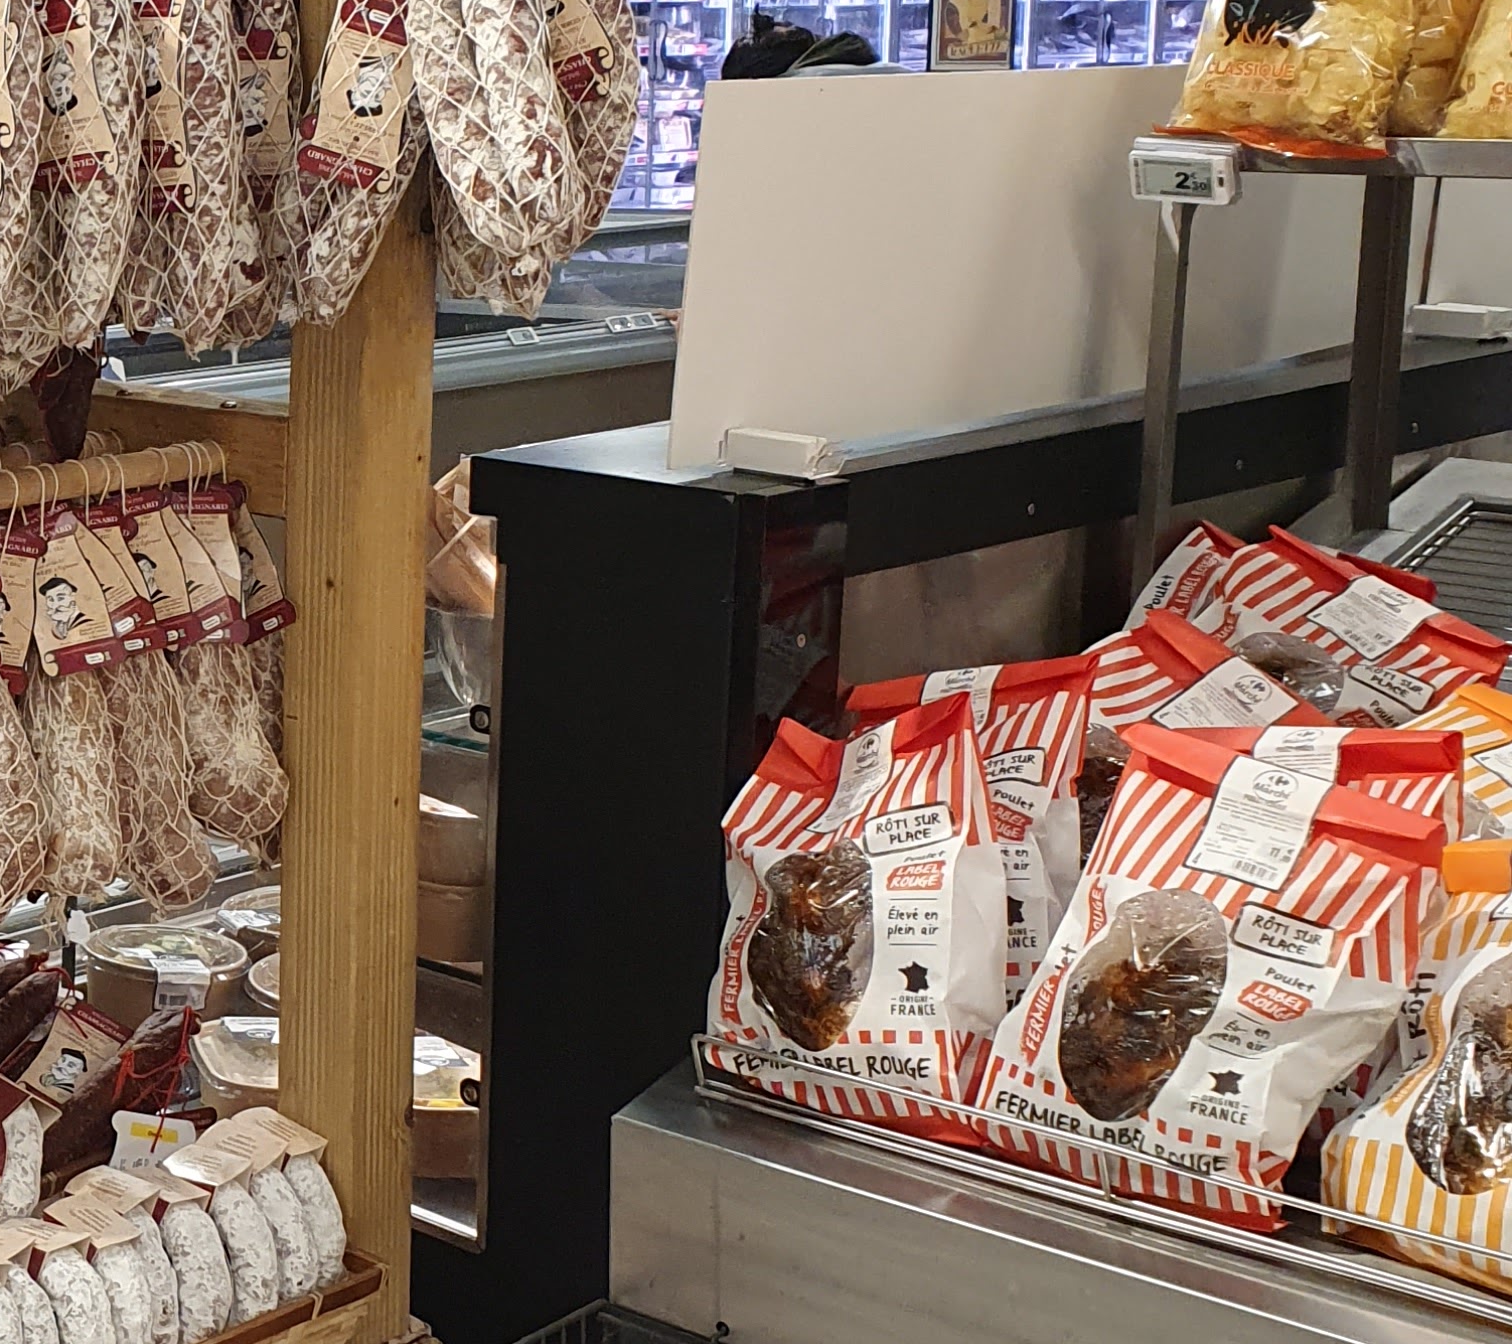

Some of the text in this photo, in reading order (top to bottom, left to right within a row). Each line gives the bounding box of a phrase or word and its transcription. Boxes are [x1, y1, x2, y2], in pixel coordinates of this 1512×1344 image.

[1207, 61, 1295, 80] CLASSIQUE
[1011, 754, 1036, 766] SUR
[994, 788, 1036, 812] Poulet
[876, 812, 942, 835] RÔTI SUR
[889, 827, 933, 845] PLACE
[1016, 848, 1030, 858] en
[895, 863, 941, 875] LABEL
[890, 874, 940, 888] ROUGE
[887, 905, 939, 922] Élevé en
[887, 923, 940, 939] plein air
[1252, 915, 1323, 947] RÔTI SUR
[1259, 933, 1309, 956] PLACE
[723, 952, 739, 1013] FERMIER
[1265, 967, 1317, 994] Poulet
[890, 1003, 936, 1016] FRANCE
[1253, 984, 1304, 1013] LABEL
[1025, 979, 1057, 1052] FERMIER
[866, 1056, 932, 1080] ROUGE
[995, 1090, 1082, 1135] FERMIER
[1089, 1125, 1146, 1156] LABEL
[1190, 1102, 1249, 1126] FRANCE
